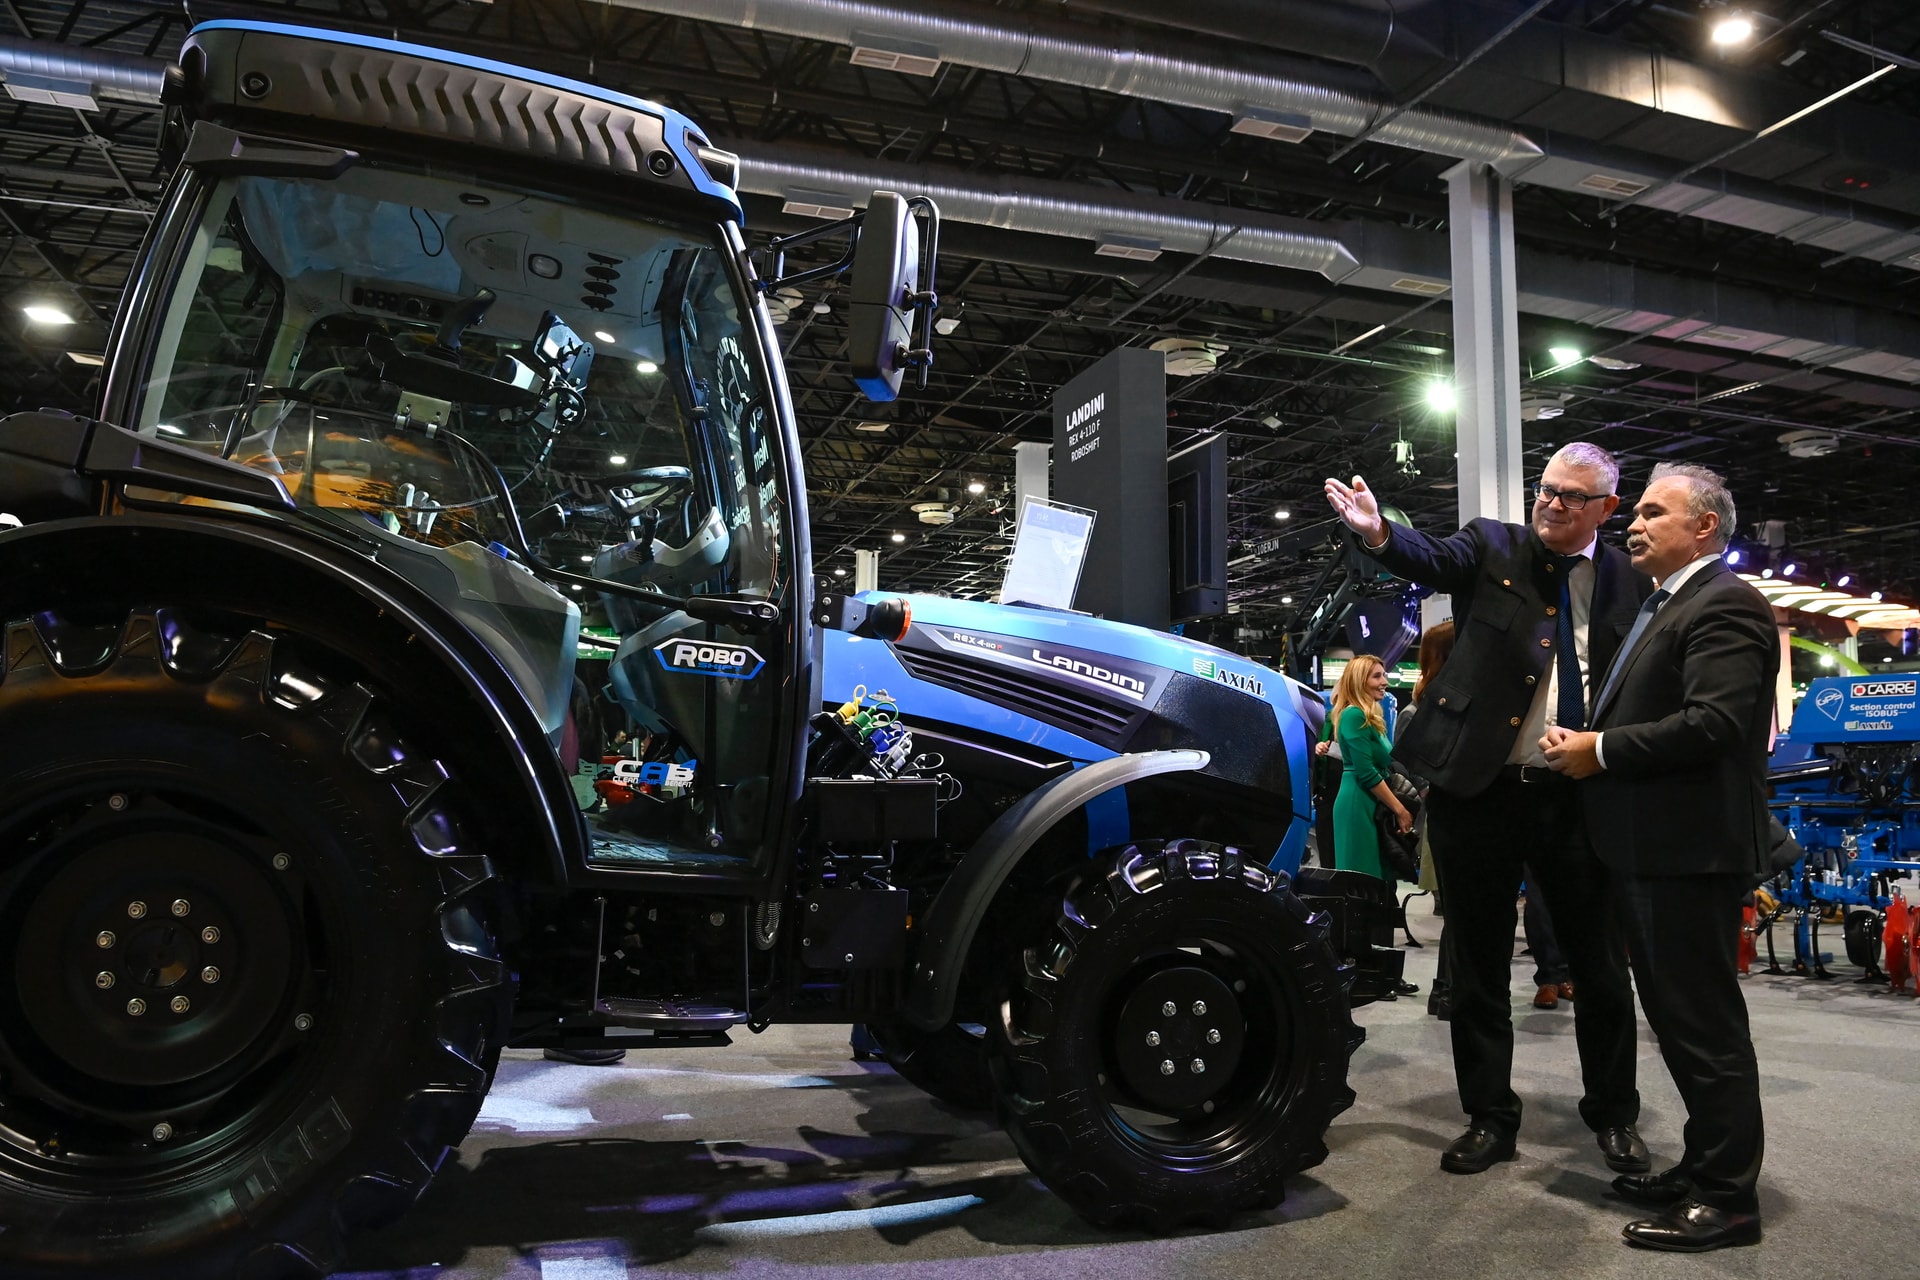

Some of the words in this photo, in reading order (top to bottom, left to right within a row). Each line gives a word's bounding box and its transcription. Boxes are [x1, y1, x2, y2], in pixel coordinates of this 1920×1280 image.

[1066, 392, 1105, 432] LANDINI
[1068, 432, 1079, 448] REX
[1080, 422, 1096, 440] 4-110
[1097, 419, 1101, 431] F
[1071, 436, 1100, 463] ROBOSHIFT
[953, 632, 976, 645] REX
[673, 644, 747, 667] ROBO
[1032, 649, 1146, 694] LANDINI
[1217, 670, 1265, 697] AXIÁL
[1849, 703, 1882, 712] Section
[1883, 701, 1916, 710] control
[1865, 709, 1898, 717] ISOBUS
